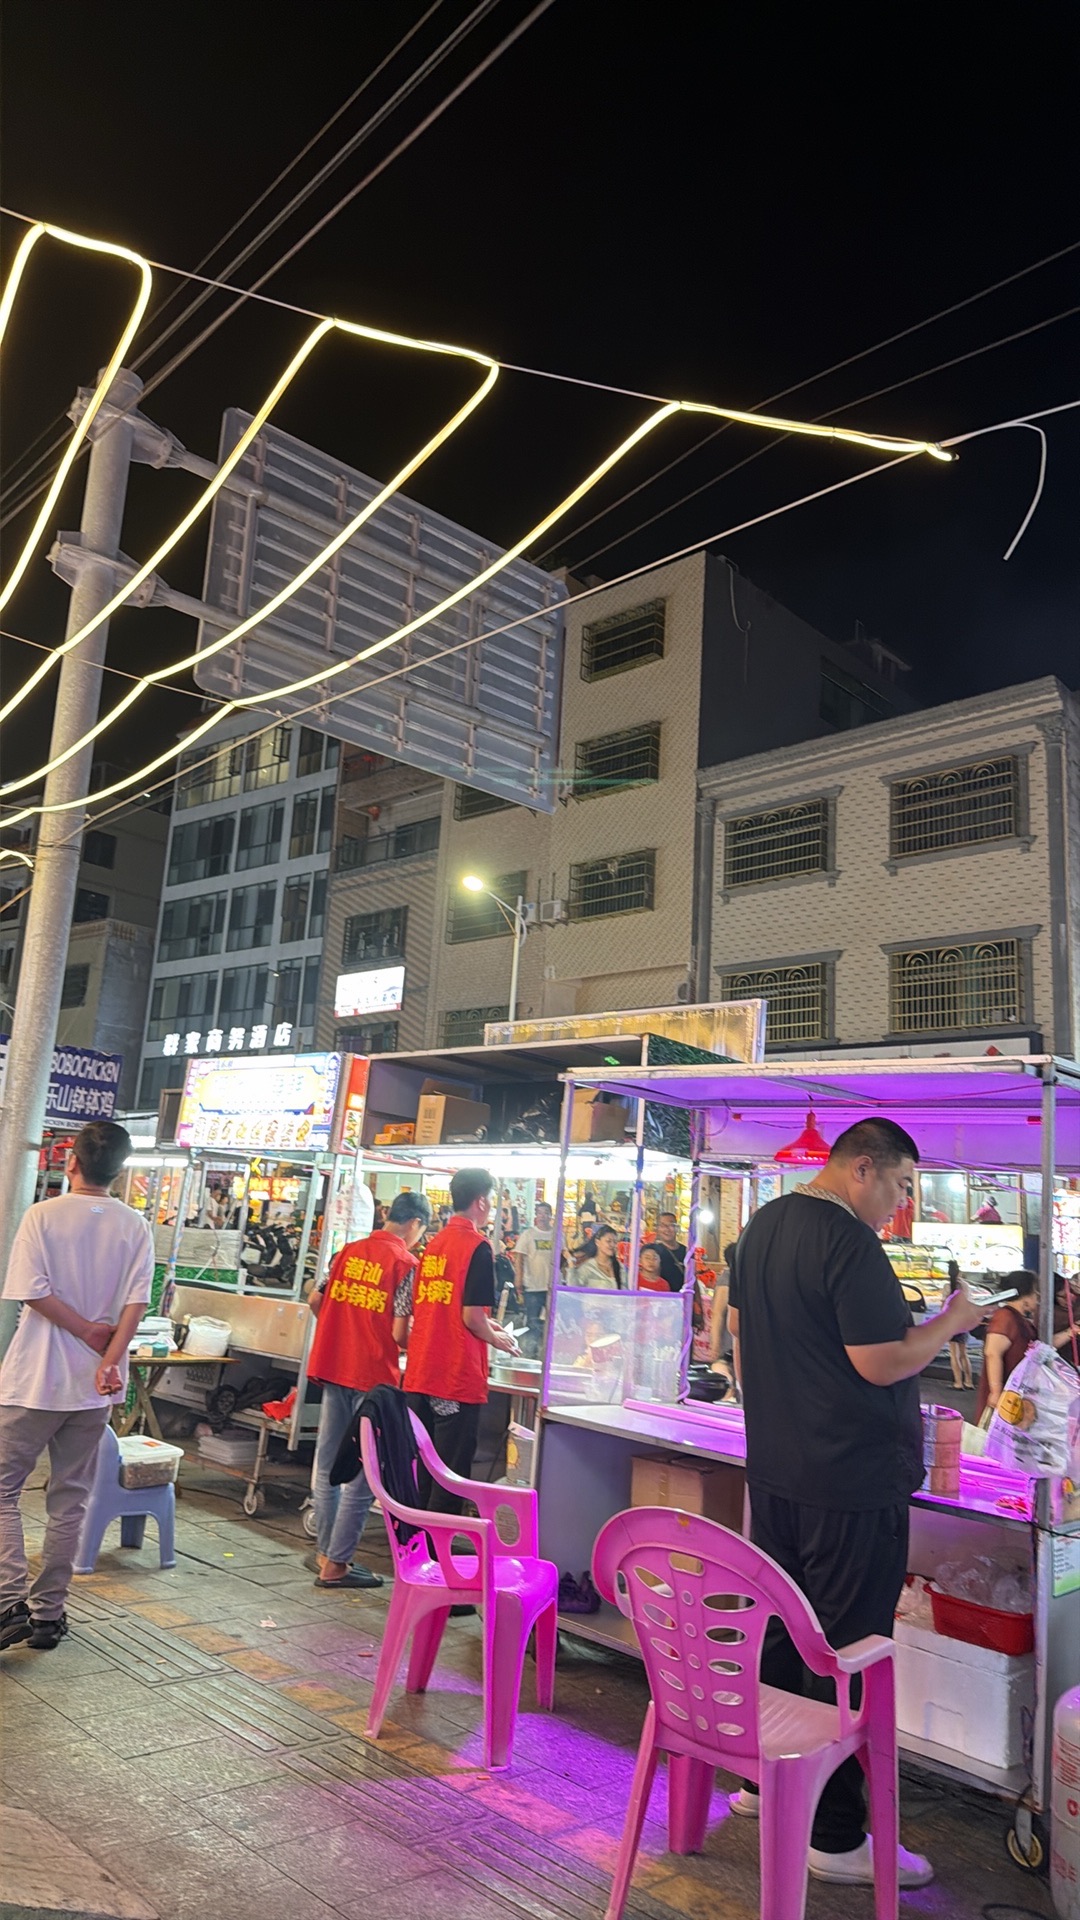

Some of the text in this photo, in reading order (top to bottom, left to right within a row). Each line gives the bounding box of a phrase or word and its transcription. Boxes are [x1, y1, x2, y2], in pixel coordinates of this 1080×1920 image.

[343, 1256, 384, 1286] 潮汕
[329, 1279, 388, 1314] 砂锅粥
